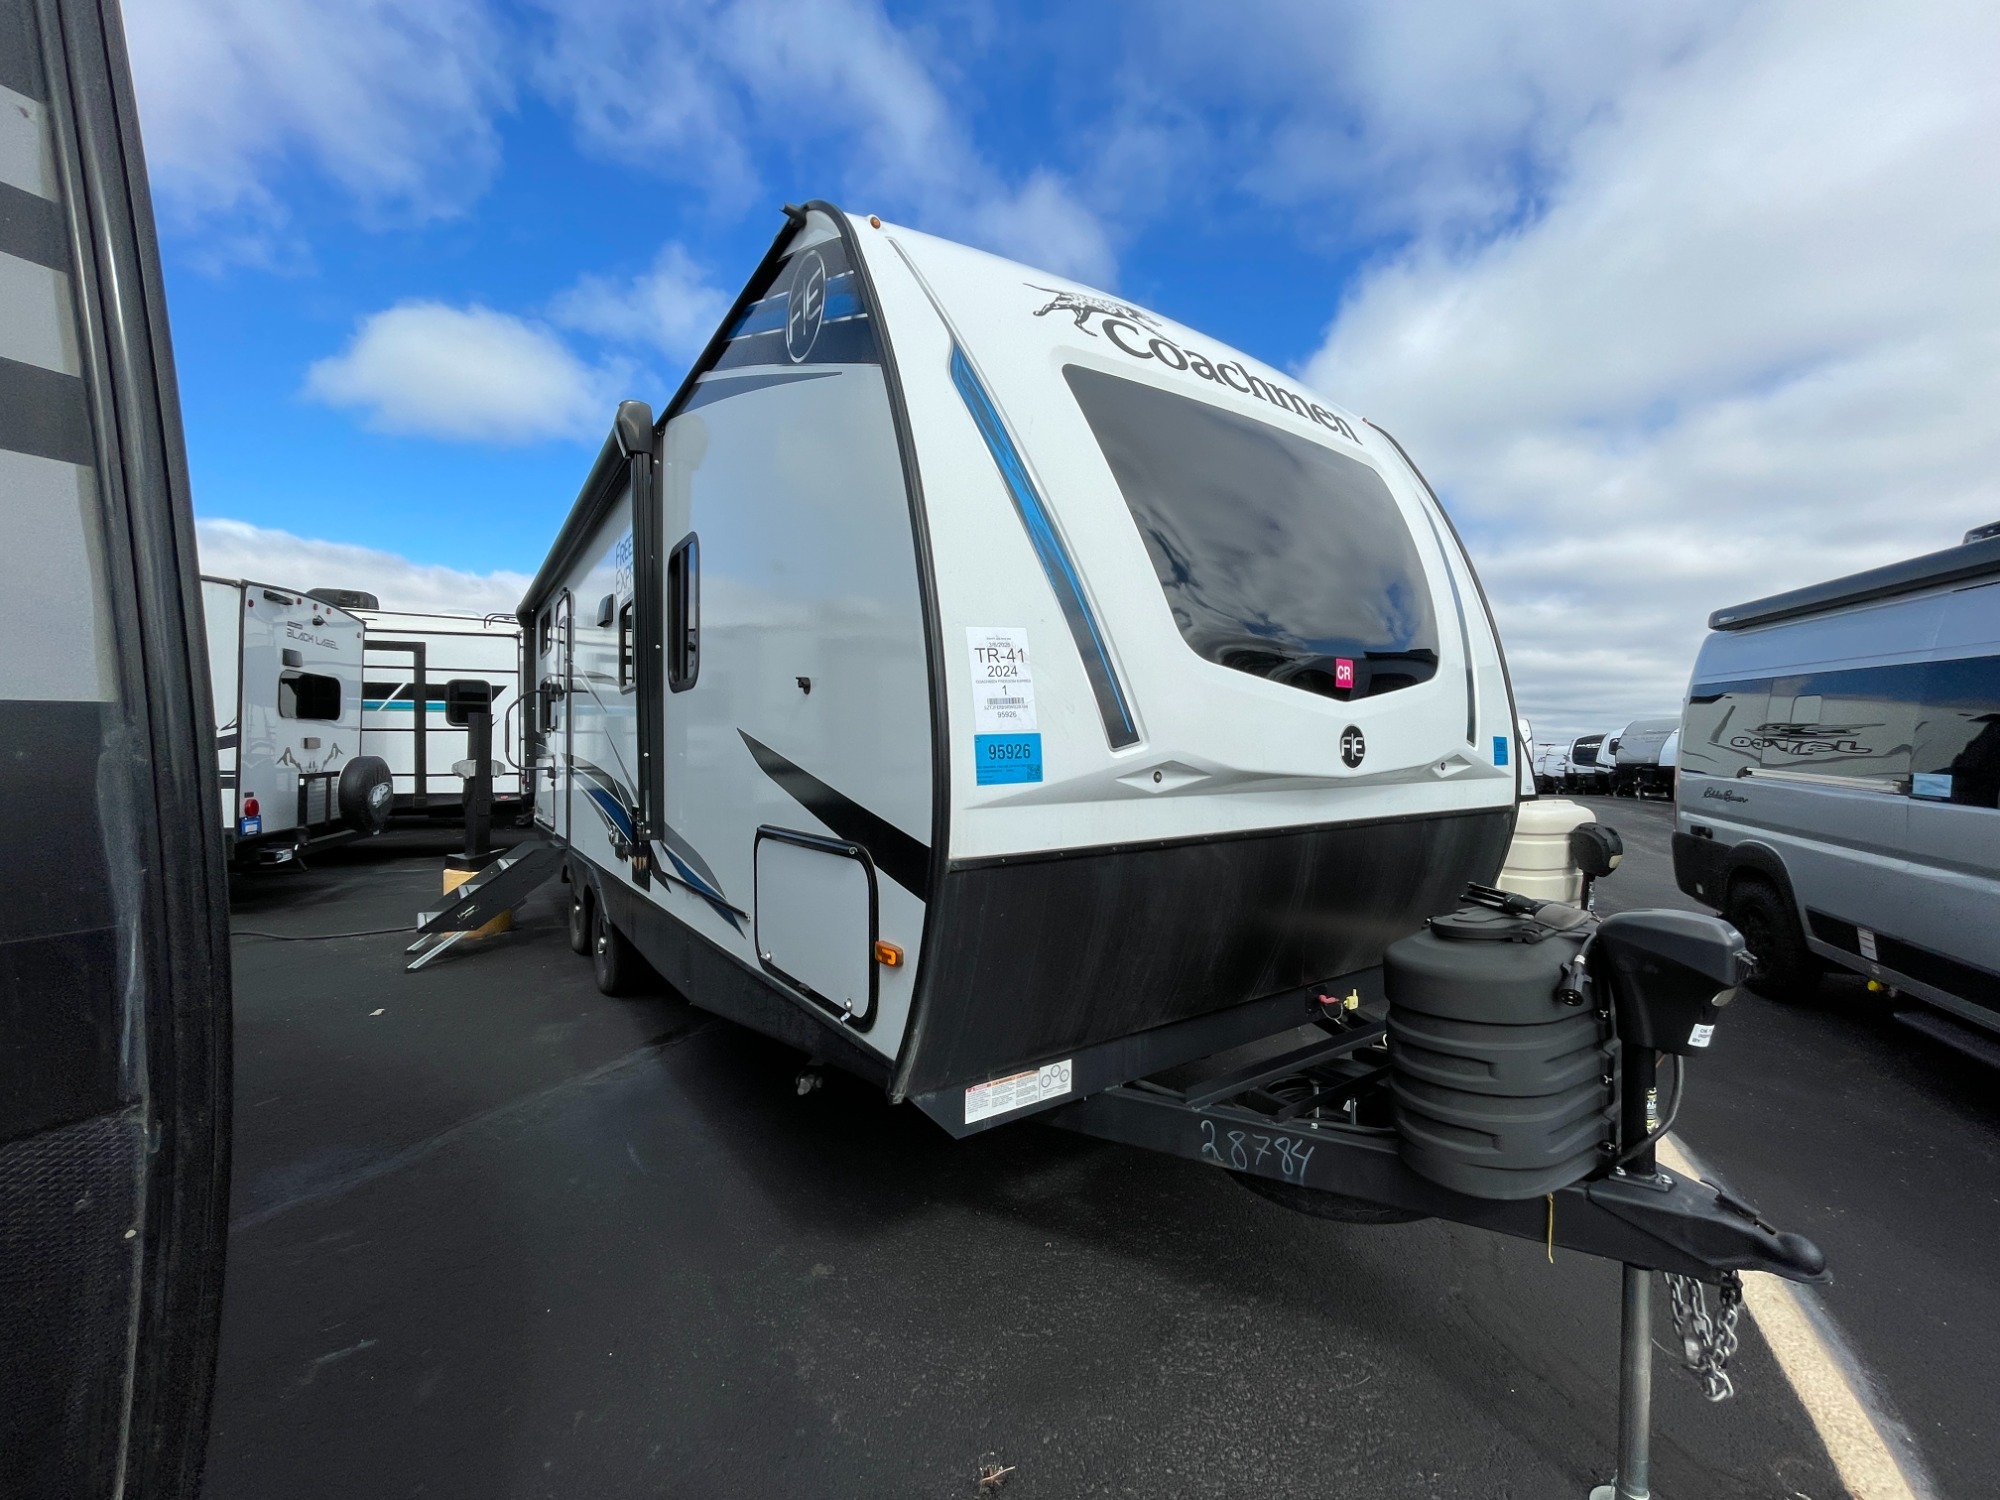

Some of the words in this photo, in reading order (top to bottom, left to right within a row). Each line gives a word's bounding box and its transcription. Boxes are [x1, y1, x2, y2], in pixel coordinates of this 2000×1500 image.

[1101, 318, 1364, 446] Coachmen
[974, 647, 1025, 664] TR-41
[987, 665, 1018, 678] 2024
[1337, 665, 1351, 681] CR
[1002, 684, 1007, 696] 1
[997, 710, 1018, 719] 95926
[988, 743, 1031, 760] 95926
[1200, 1119, 1315, 1178] 28784
